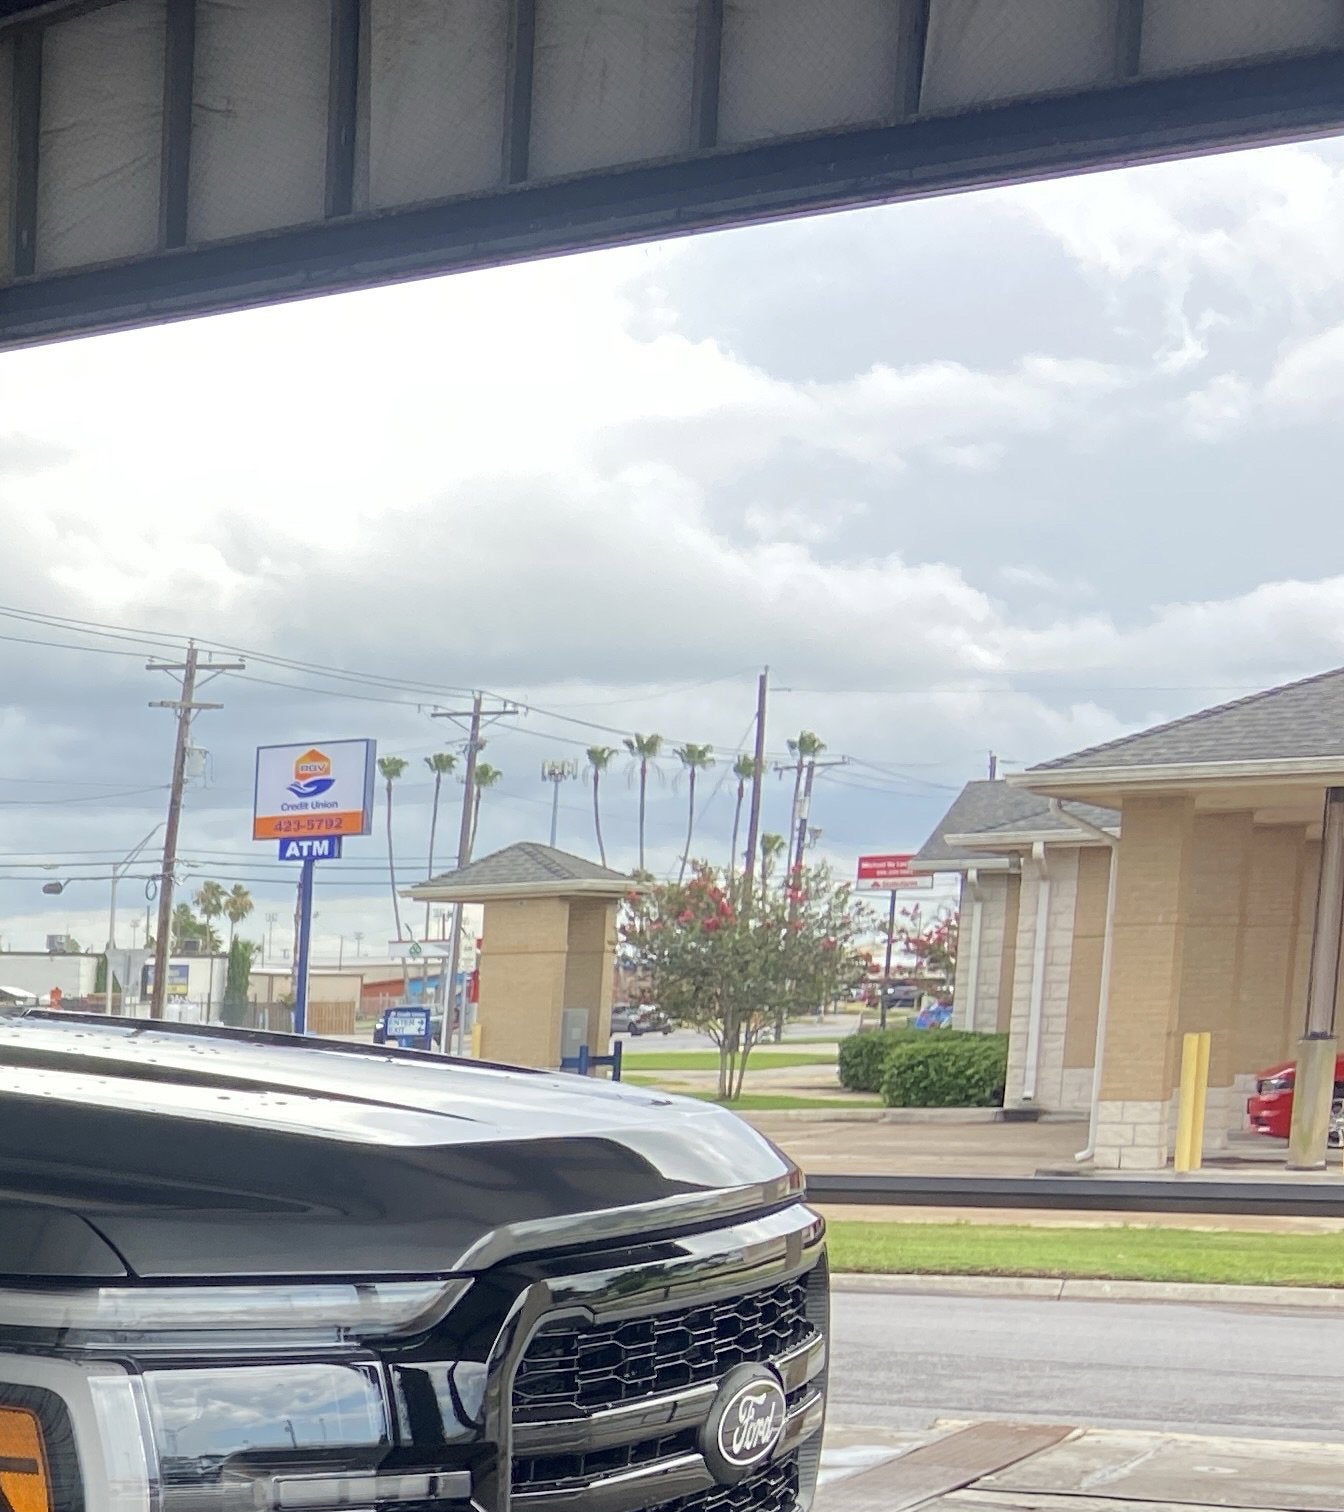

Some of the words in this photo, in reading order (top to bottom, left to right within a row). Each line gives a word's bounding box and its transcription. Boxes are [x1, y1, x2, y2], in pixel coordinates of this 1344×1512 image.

[281, 802, 309, 811] Credit
[311, 800, 338, 809] Union
[285, 840, 330, 857] ATM
[733, 1392, 776, 1455] Ford
